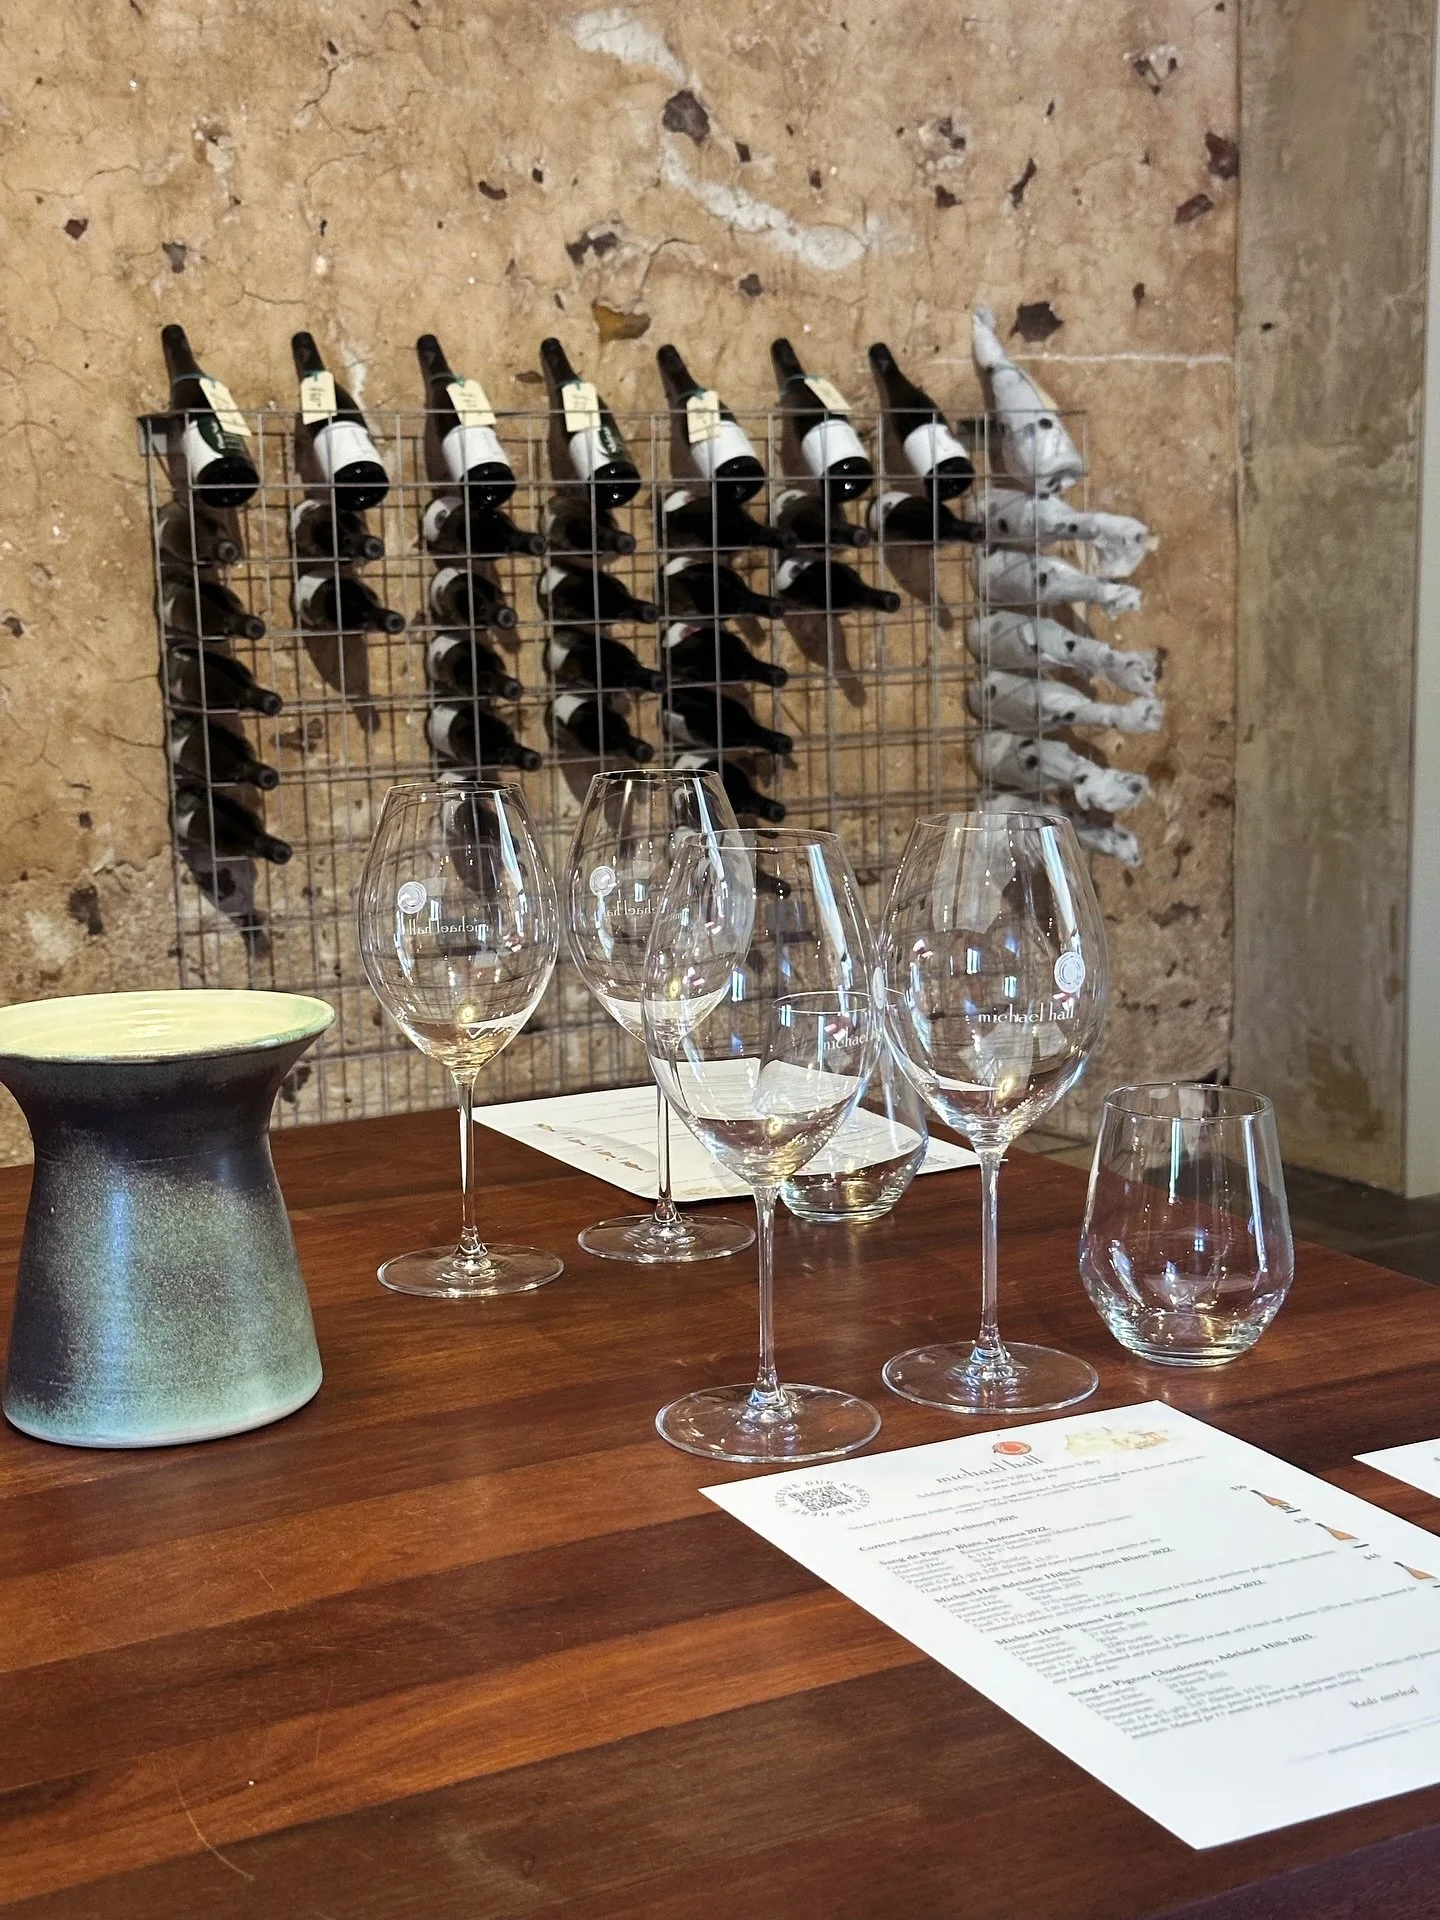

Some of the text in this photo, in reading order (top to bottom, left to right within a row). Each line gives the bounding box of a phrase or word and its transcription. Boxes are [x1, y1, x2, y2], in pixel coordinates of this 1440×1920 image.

[978, 1002, 1074, 1023] michael hall
[936, 1455, 1043, 1483] michael hall
